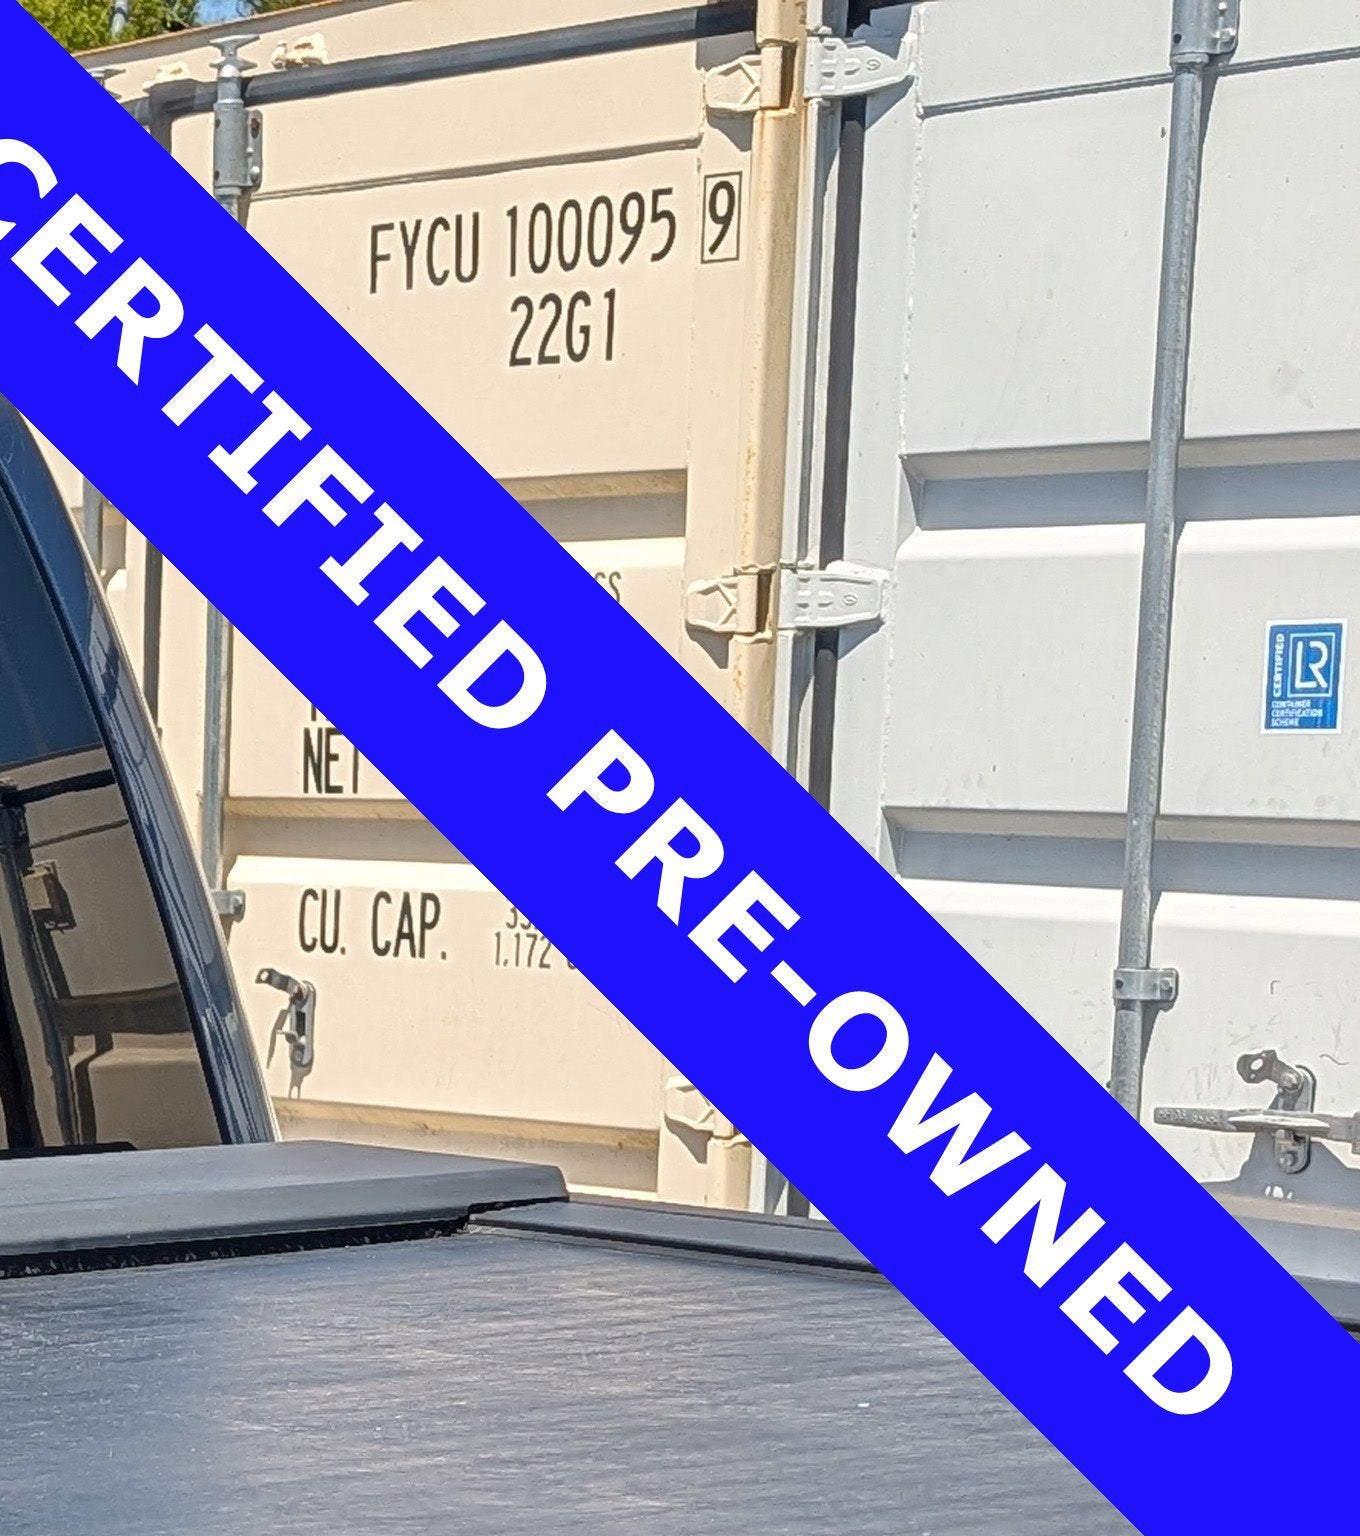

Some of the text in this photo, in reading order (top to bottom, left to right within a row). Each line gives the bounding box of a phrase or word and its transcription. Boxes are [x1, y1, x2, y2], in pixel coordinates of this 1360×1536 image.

[370, 180, 735, 294] FYCU 100095 9
[509, 288, 617, 367] 22G1
[1294, 641, 1328, 688] LR
[299, 889, 447, 960] CU. CAP.
